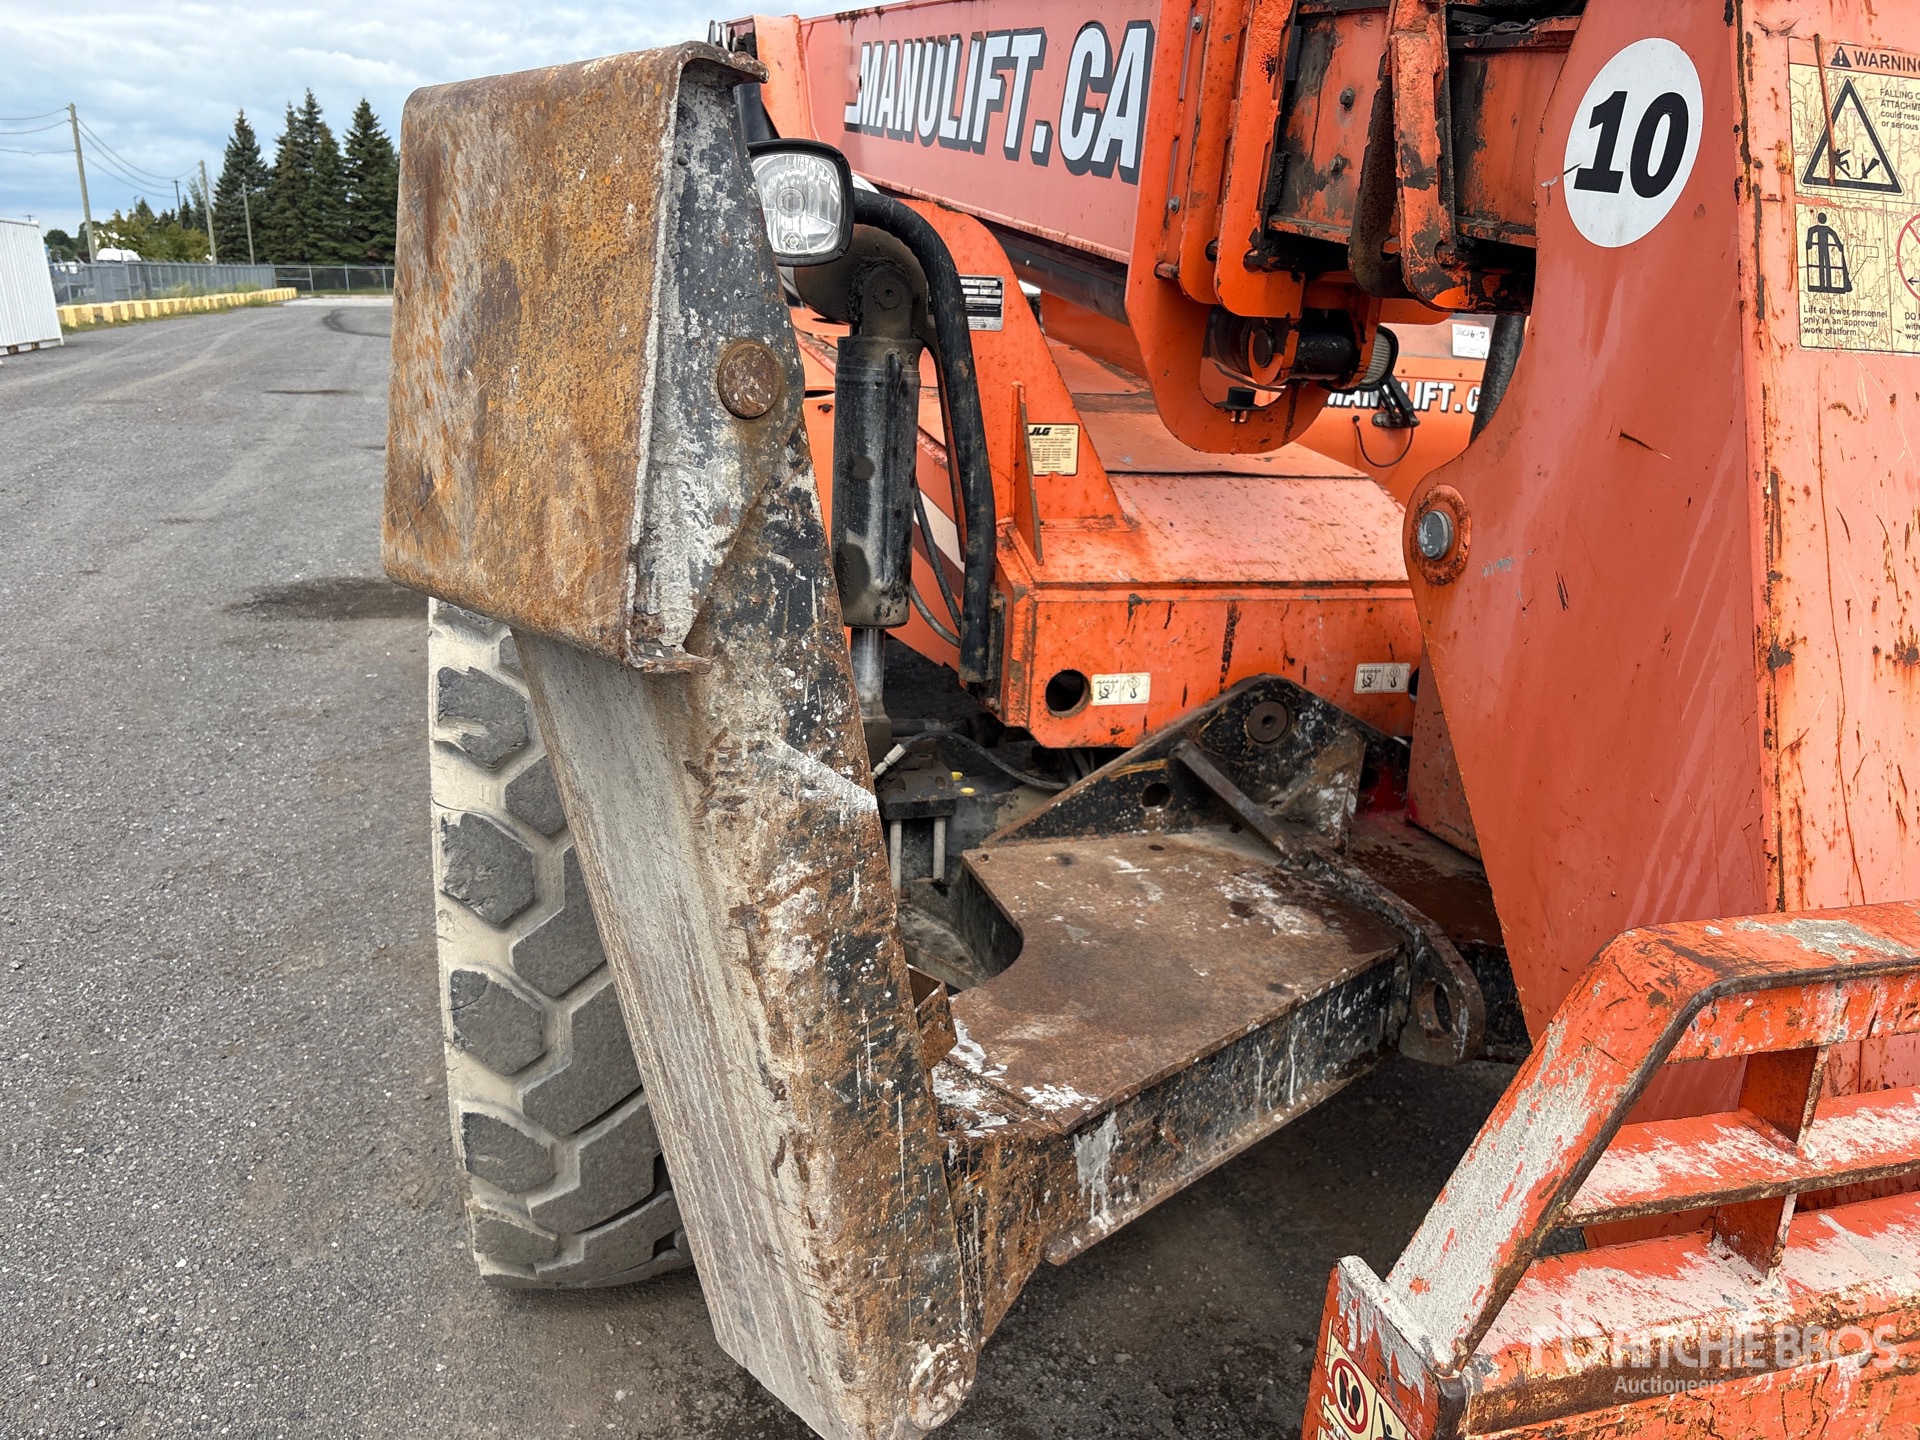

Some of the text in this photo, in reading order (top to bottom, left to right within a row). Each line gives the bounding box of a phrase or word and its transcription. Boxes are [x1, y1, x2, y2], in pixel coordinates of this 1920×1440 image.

[1854, 51, 1920, 73] WARNIN
[1880, 89, 1913, 100] FALLING
[845, 20, 1155, 185] MANULIFT.CA
[1880, 111, 1902, 119] could
[1891, 121, 1919, 131] serious
[1574, 91, 1690, 199] 10
[1803, 305, 1817, 314] Lift
[1829, 306, 1850, 316] lower
[1852, 309, 1888, 318] personnel
[1905, 312, 1916, 320] DO
[1803, 316, 1820, 326] only
[1822, 316, 1830, 324] in
[1844, 319, 1878, 328] approved
[1029, 427, 1051, 436] JLG
